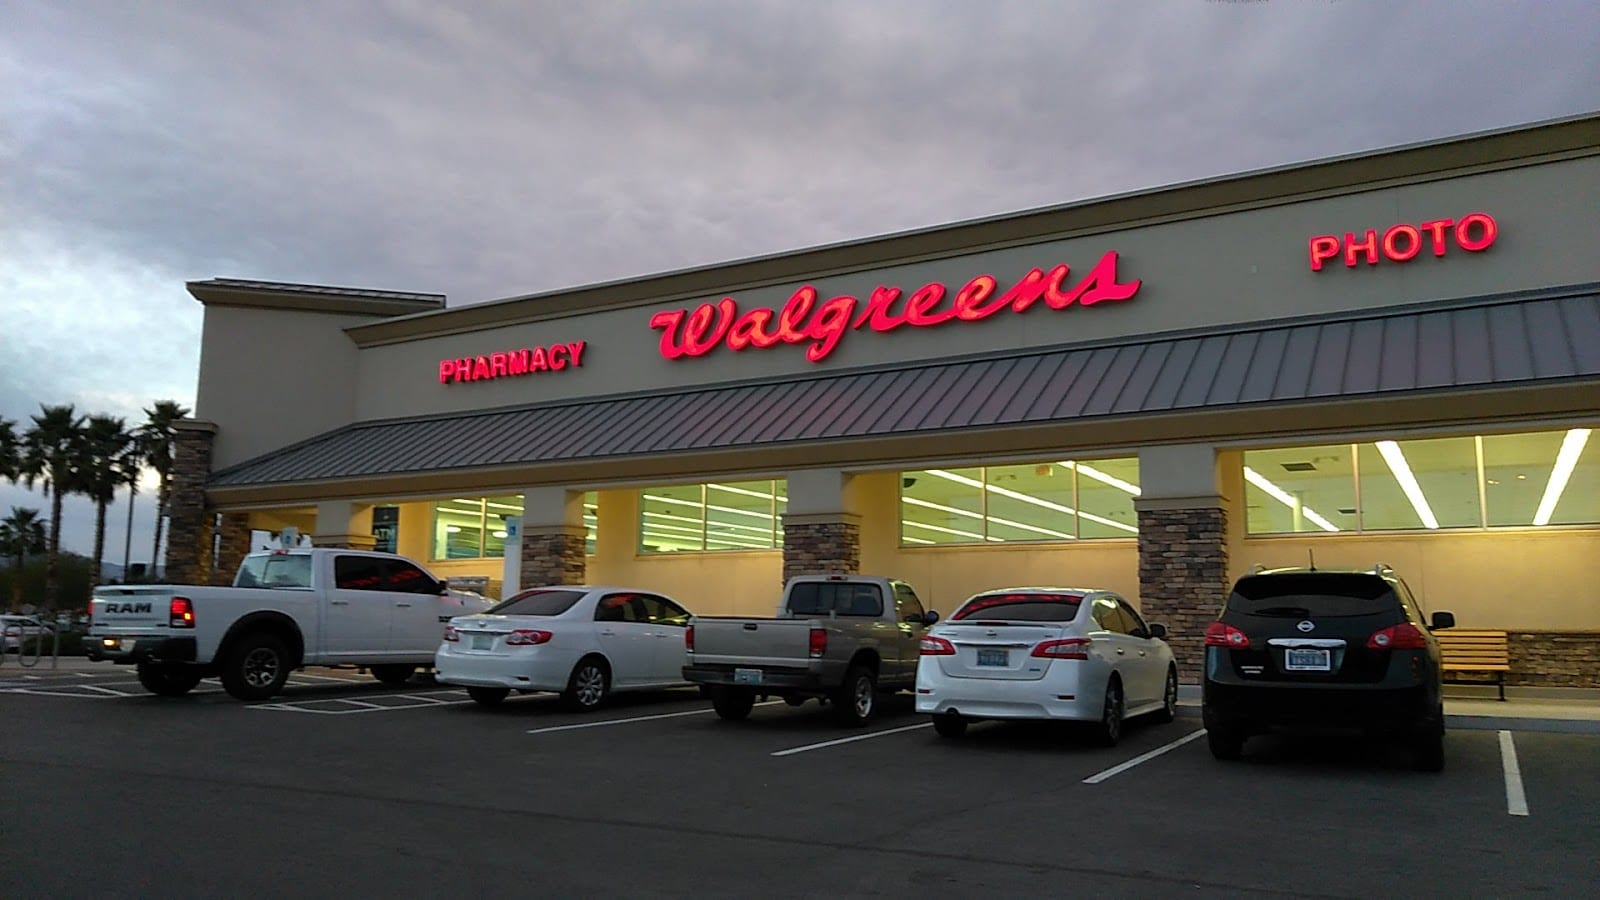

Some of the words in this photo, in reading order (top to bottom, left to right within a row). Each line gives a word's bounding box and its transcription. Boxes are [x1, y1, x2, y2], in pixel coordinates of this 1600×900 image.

[1309, 212, 1498, 271] PHOTO
[649, 250, 1141, 363] Walgreens
[439, 340, 585, 384] PHARMACY
[105, 602, 152, 614] RAM
